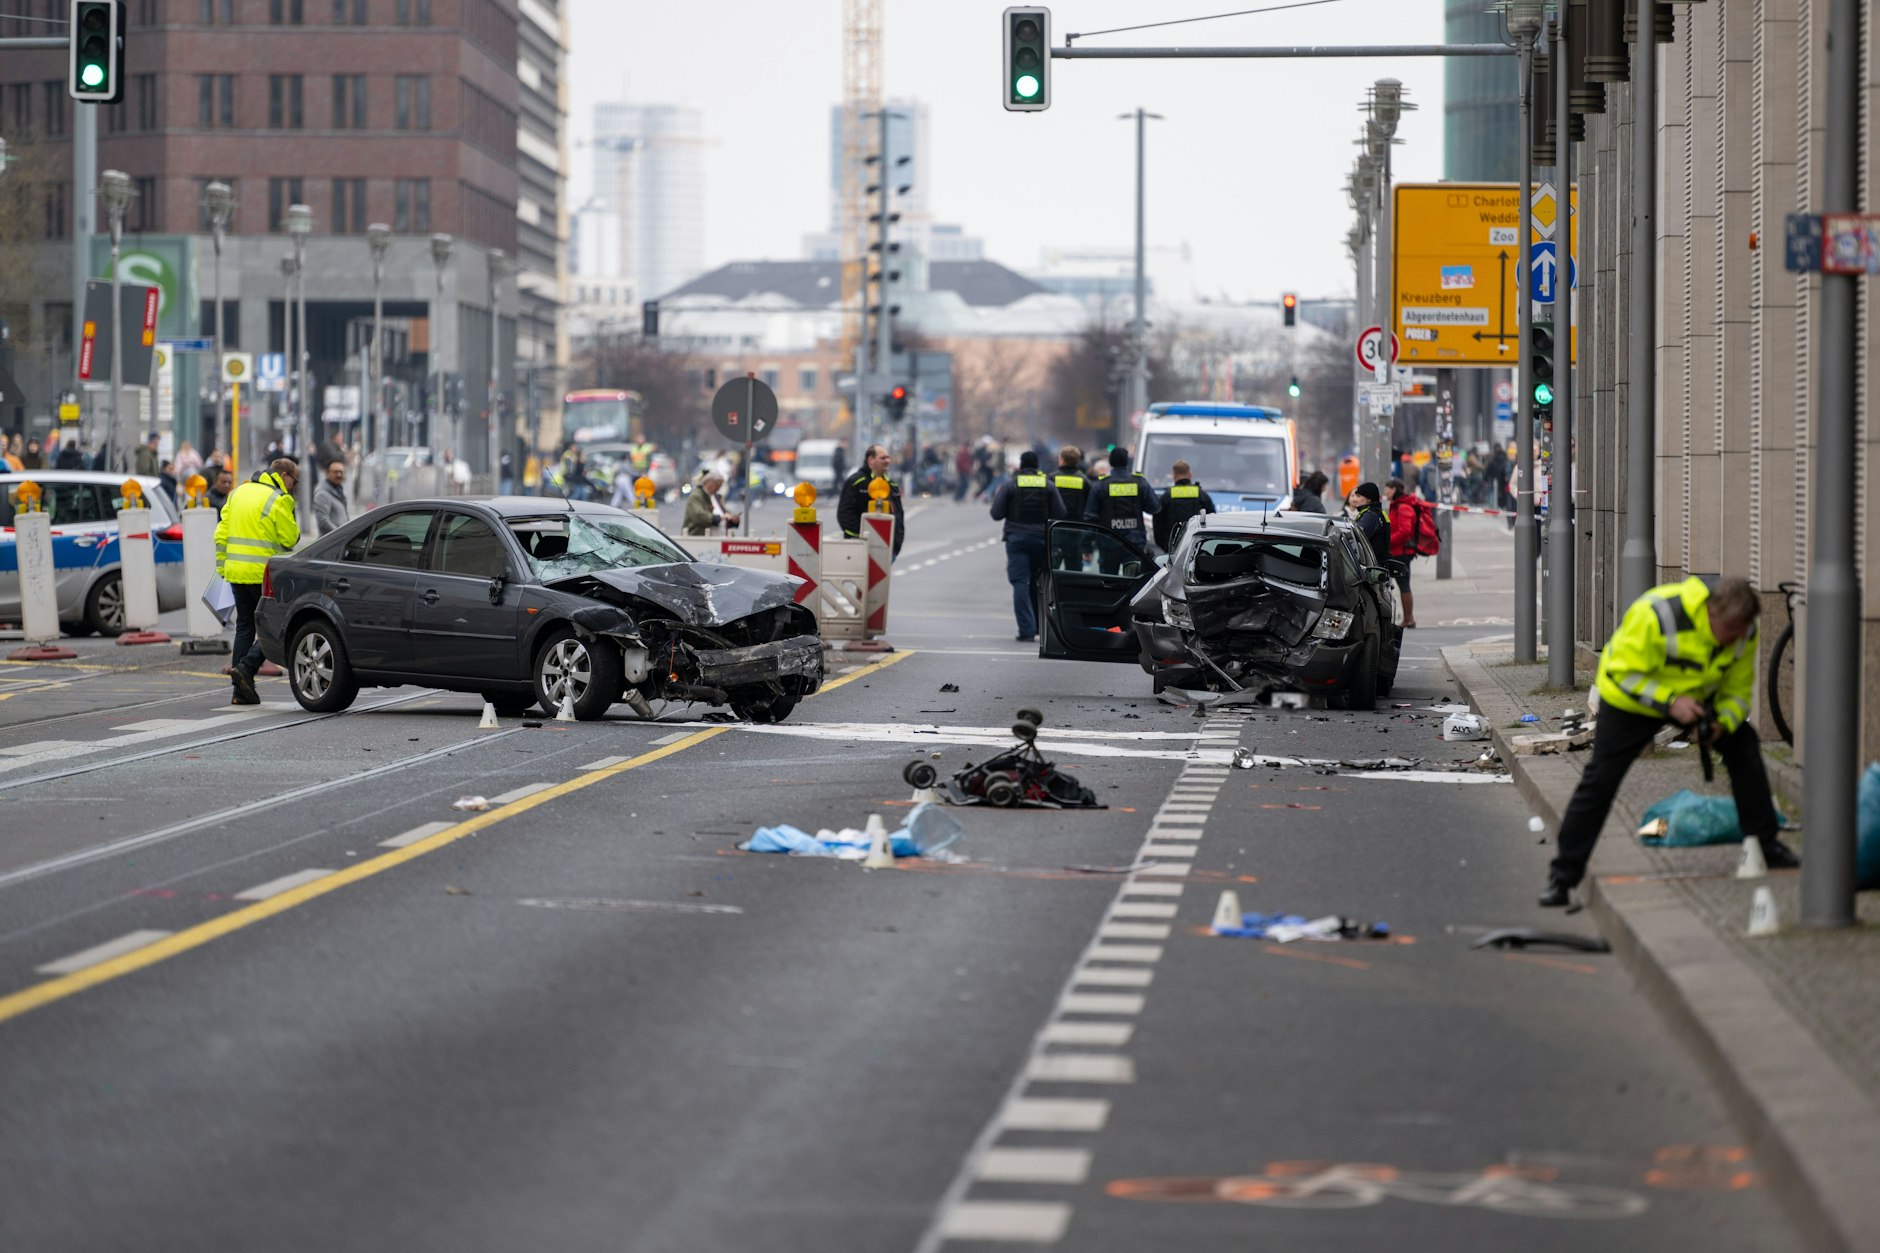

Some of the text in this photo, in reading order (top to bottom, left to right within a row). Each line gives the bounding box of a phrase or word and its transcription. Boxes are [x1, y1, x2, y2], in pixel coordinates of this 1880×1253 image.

[1473, 195, 1520, 207] Charlott
[1493, 231, 1515, 242] Zoo
[1401, 292, 1462, 305] Kreuzberg
[1405, 311, 1485, 325] Abgeordnetenhaus
[261, 353, 282, 379] U
[1111, 517, 1137, 529] POLIZEI
